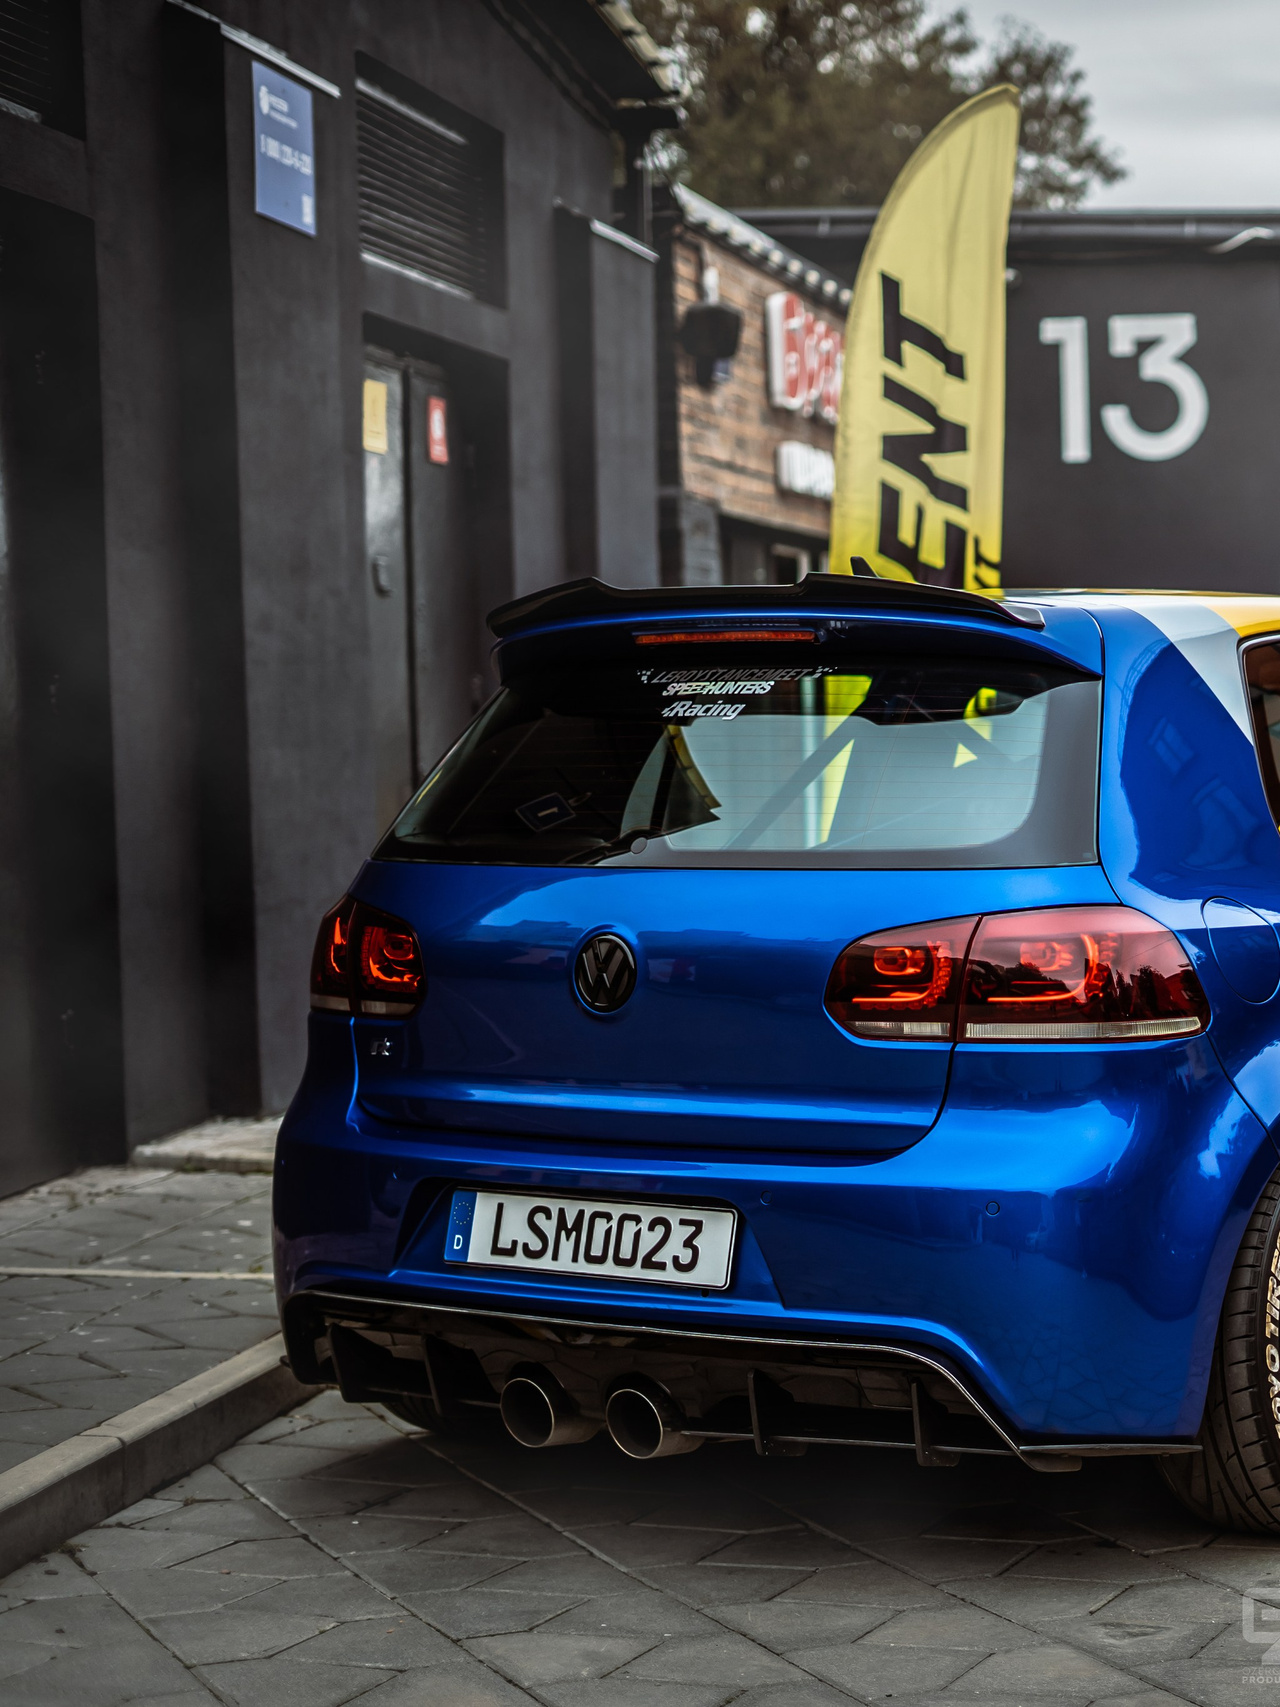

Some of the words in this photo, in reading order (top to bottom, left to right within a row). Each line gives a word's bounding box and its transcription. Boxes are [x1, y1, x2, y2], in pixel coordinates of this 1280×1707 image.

[1039, 312, 1210, 463] 13
[662, 681, 775, 696] SPEEDHUNTERS
[453, 1234, 463, 1250] D
